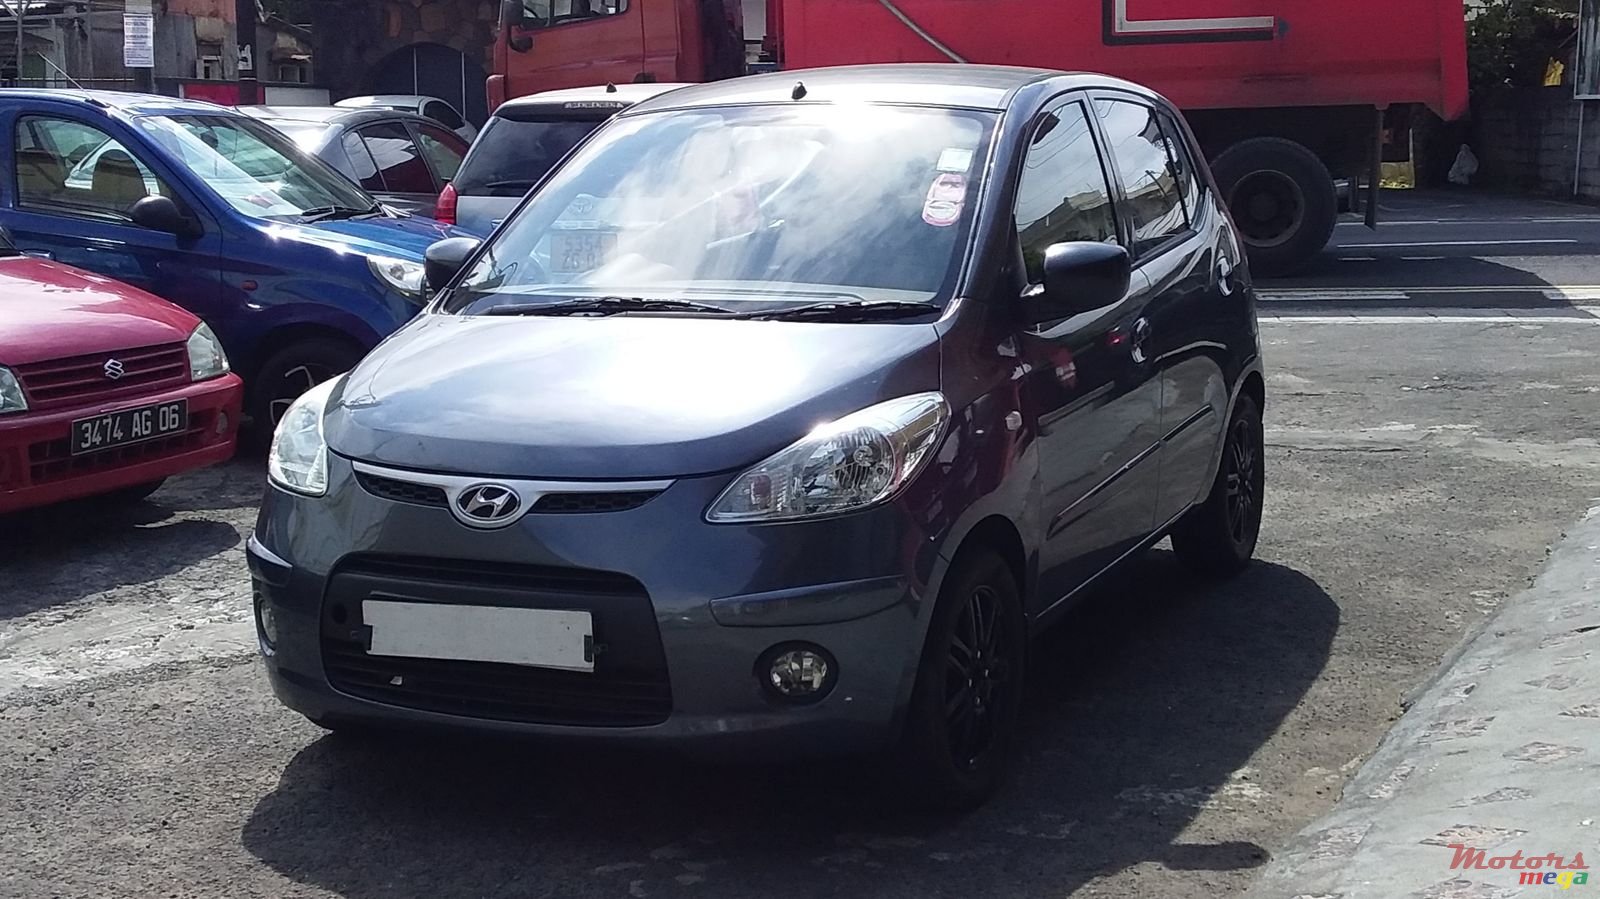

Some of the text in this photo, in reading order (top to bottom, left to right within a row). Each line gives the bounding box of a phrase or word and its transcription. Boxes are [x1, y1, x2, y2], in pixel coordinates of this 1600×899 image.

[81, 404, 179, 448] 3474 AG 06
